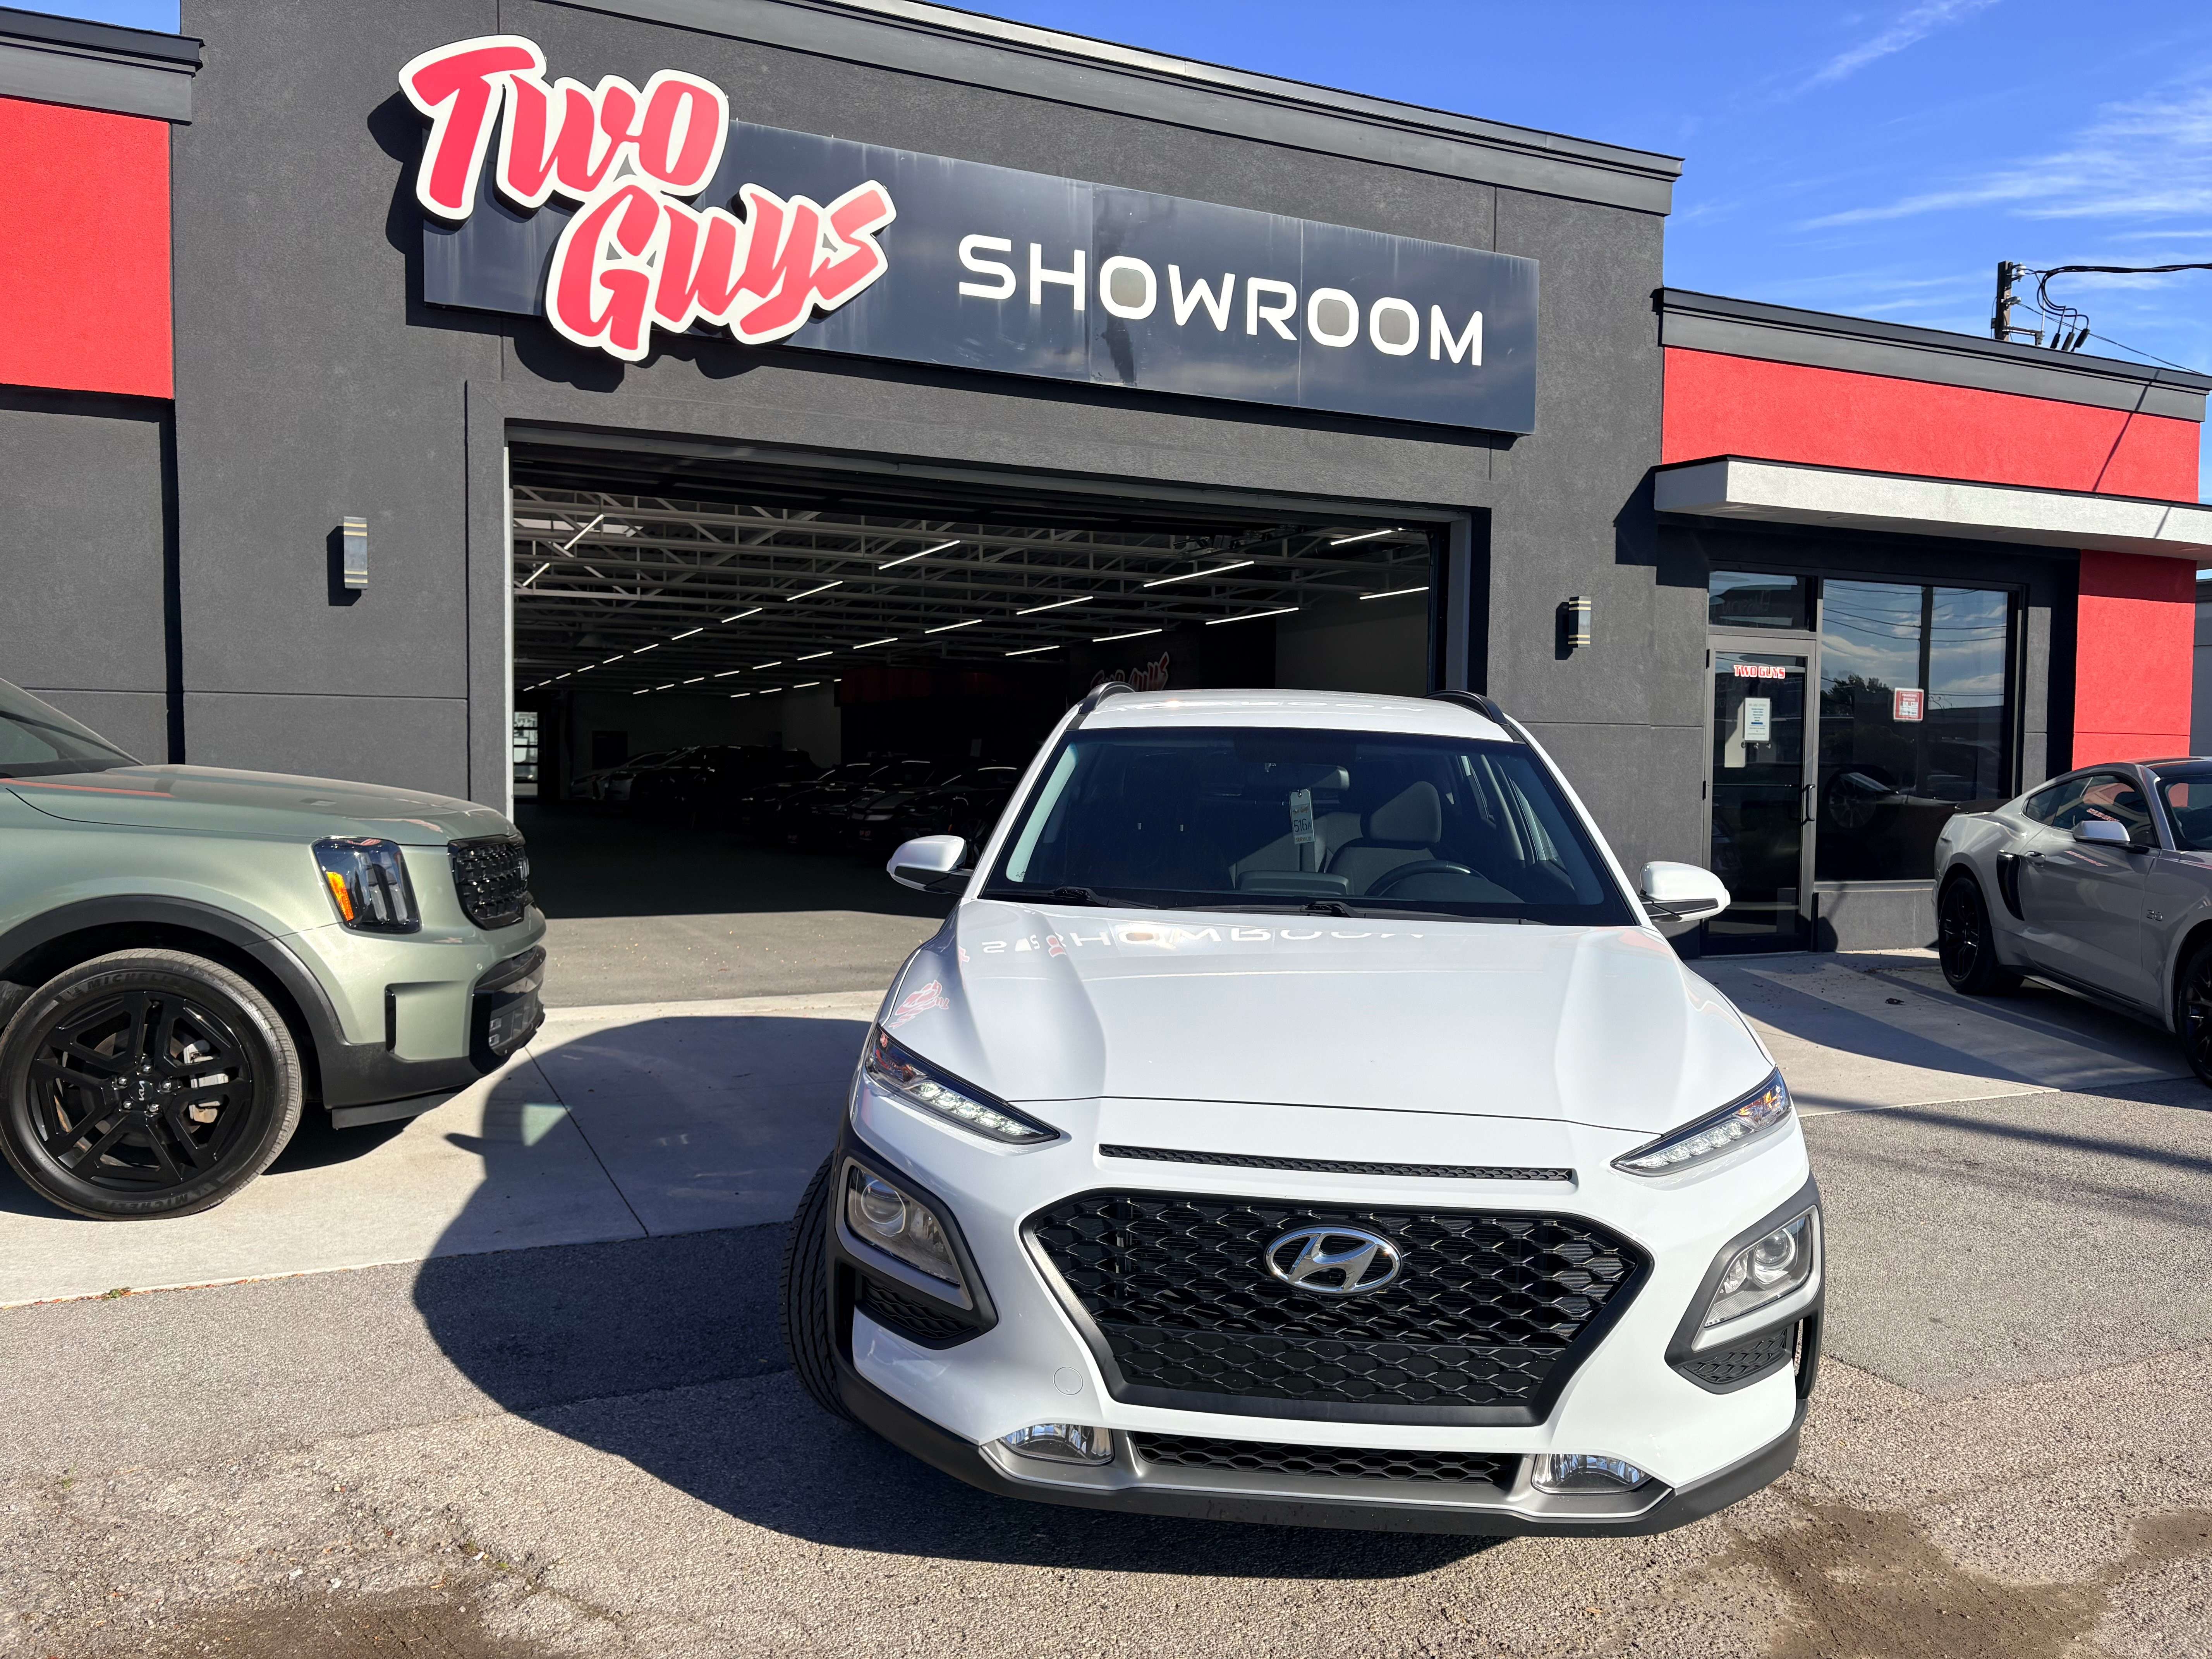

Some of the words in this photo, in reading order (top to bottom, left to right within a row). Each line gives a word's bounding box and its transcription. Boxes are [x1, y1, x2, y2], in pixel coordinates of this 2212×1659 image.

[958, 234, 1483, 366] SHOWROOM
[1734, 665, 1757, 677] TWO
[1758, 666, 1785, 679] GUYS
